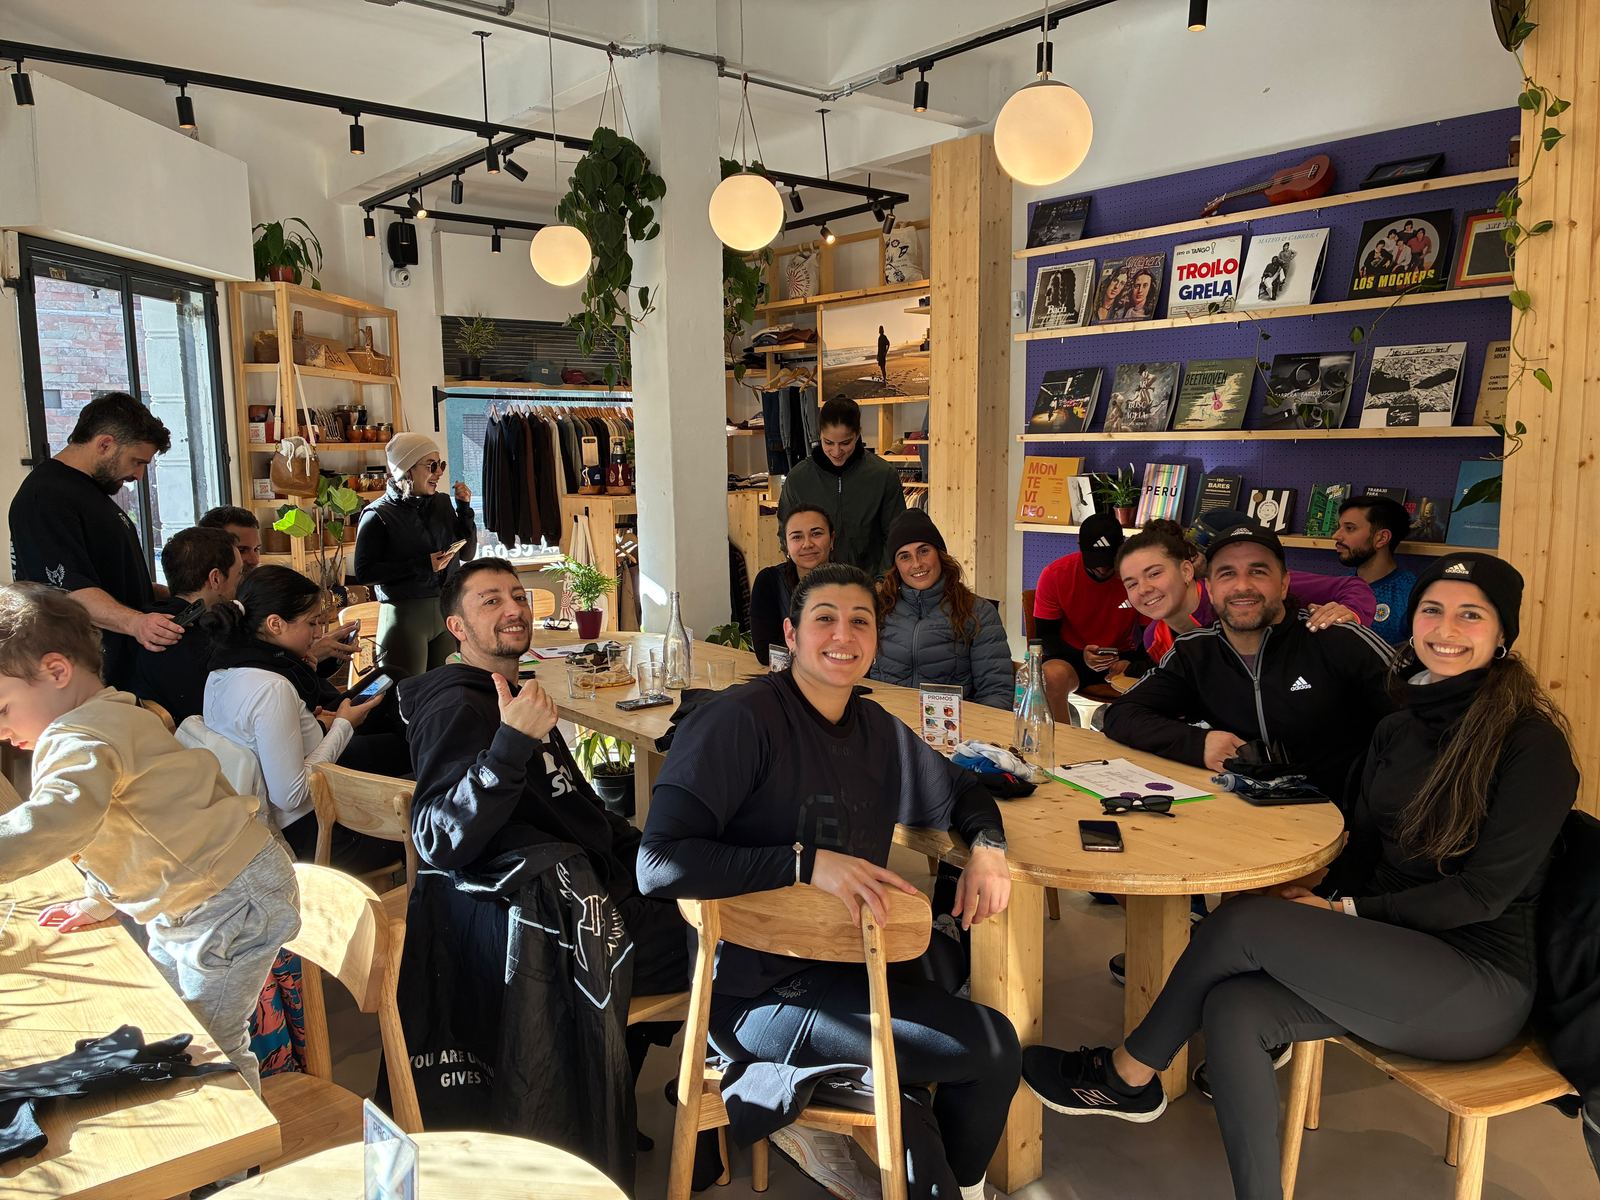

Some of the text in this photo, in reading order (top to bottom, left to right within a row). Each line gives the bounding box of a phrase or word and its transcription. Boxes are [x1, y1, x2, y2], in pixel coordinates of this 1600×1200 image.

[1177, 258, 1238, 281] TROILO
[1353, 269, 1435, 290] LOS MOCKERS
[1179, 280, 1232, 300] GRELA
[1047, 303, 1067, 315] Bach
[1185, 371, 1228, 386] BEETHOVEN
[1028, 462, 1058, 476] MON
[1026, 477, 1041, 489] TE
[1207, 482, 1231, 490] BARES
[1024, 490, 1038, 503] VI
[1145, 485, 1178, 498] PERÚ
[1021, 504, 1045, 518] DEO
[1290, 683, 1312, 692] adidas
[927, 694, 953, 702] PROMOS
[438, 1049, 465, 1065] ARE
[440, 1071, 481, 1087] GIVES
